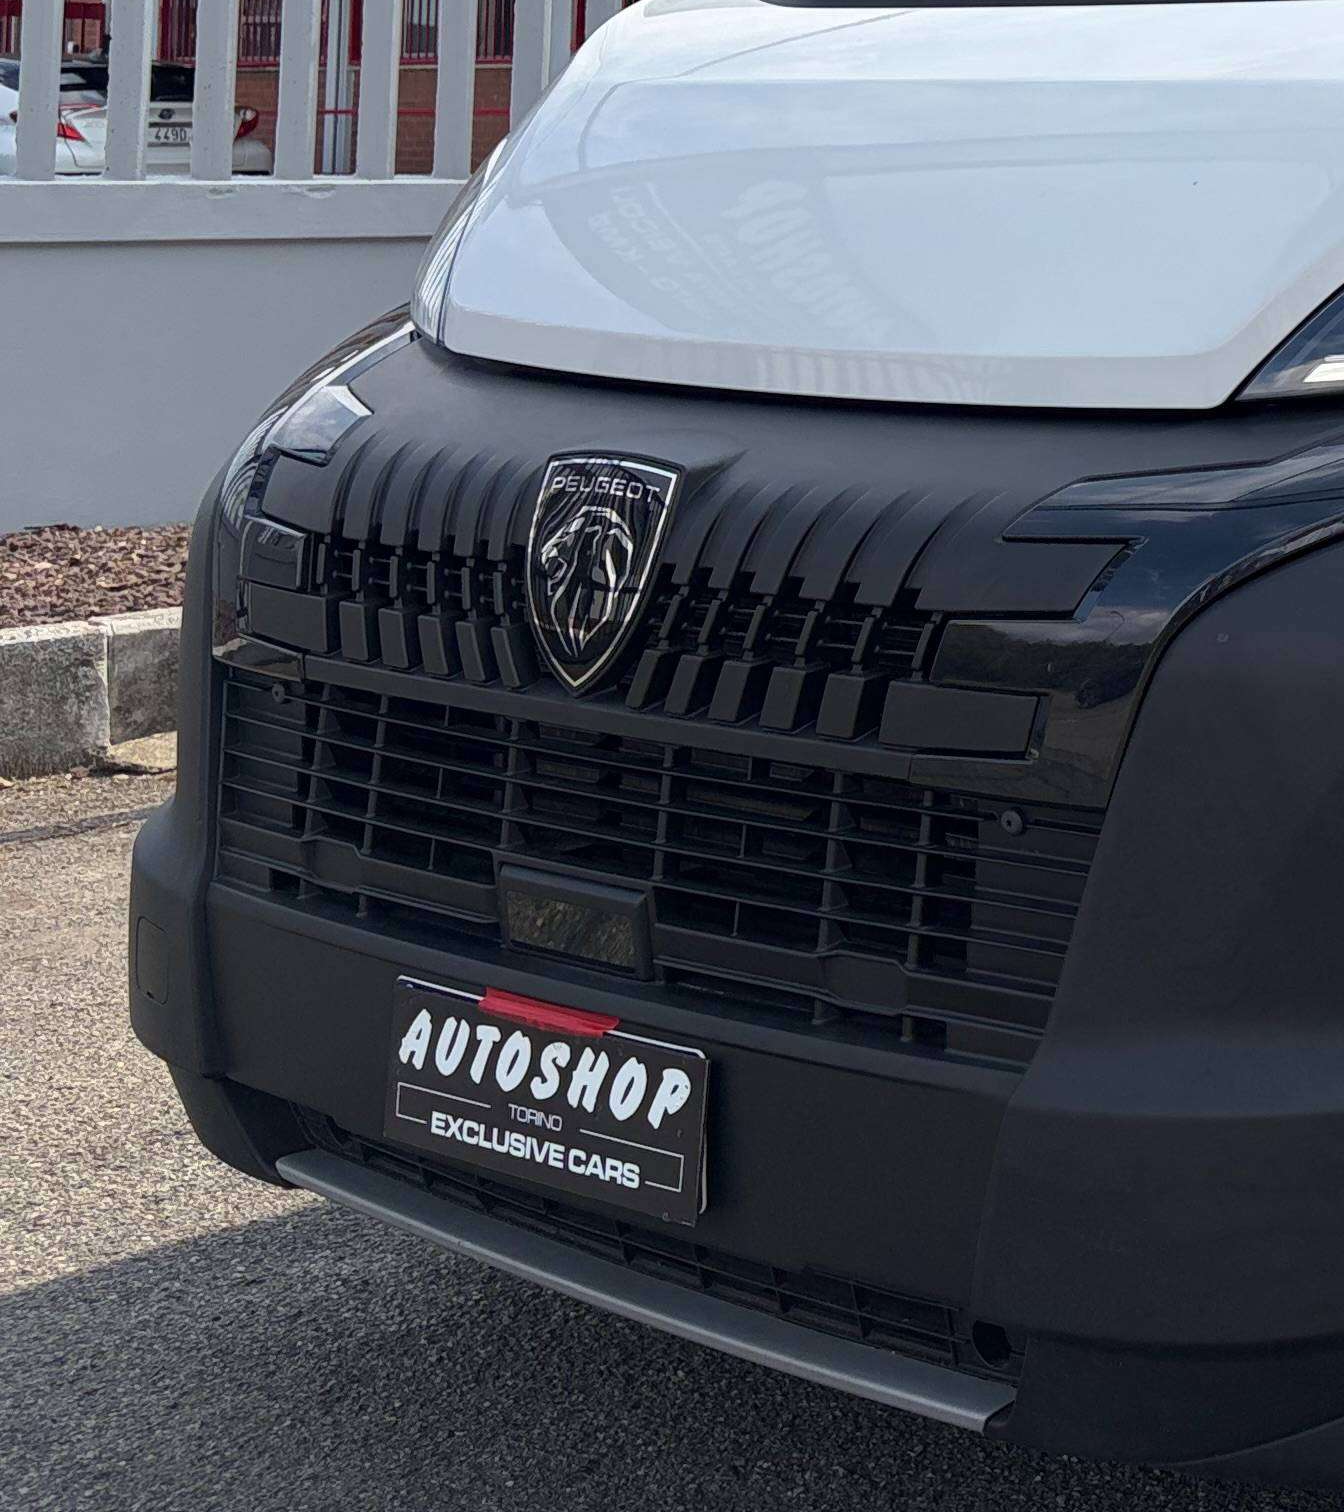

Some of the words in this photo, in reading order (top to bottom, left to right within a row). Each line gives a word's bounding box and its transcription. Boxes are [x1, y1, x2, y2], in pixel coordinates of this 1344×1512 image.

[550, 475, 661, 503] PEUGEOT
[398, 1008, 692, 1129] AUTOSHOP
[507, 1103, 563, 1132] TORINO
[430, 1110, 566, 1169] EXCLUSIVE
[568, 1148, 641, 1189] CARS
